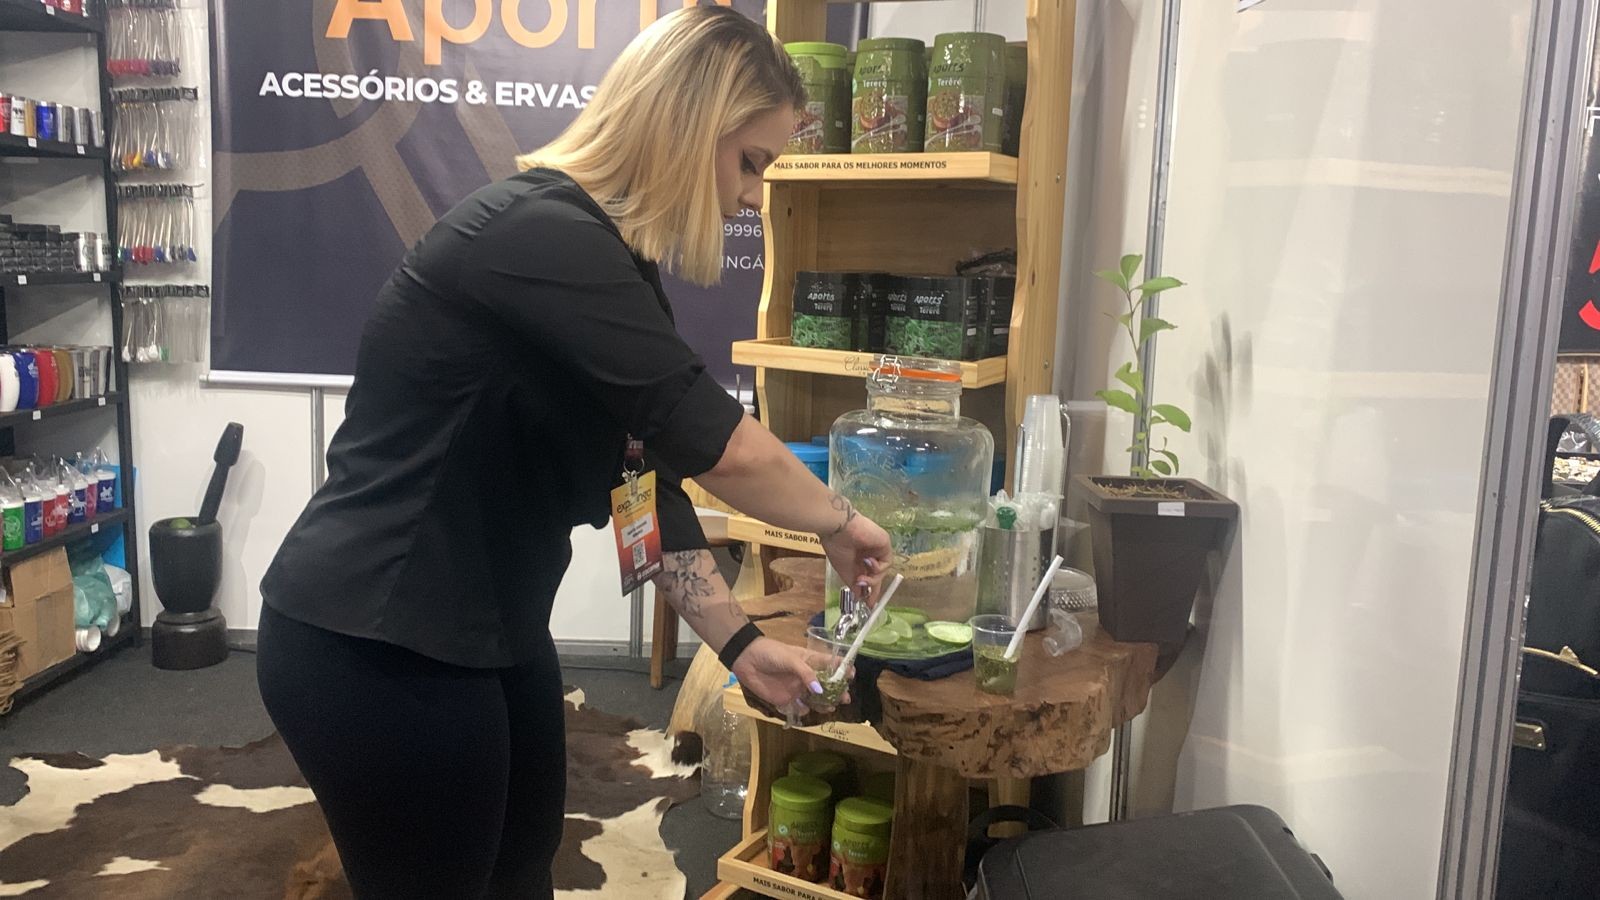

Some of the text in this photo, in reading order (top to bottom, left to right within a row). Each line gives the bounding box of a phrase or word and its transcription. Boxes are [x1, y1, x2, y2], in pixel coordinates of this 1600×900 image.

[259, 69, 458, 104] ACESSÓRIOS
[465, 80, 487, 104] &
[856, 161, 898, 169] MELHORES
[900, 161, 947, 169] MOMENTOS
[764, 530, 783, 539] MAIS
[784, 532, 808, 542] SABOR
[753, 876, 771, 888] MAIS
[772, 882, 796, 895] SABOR
